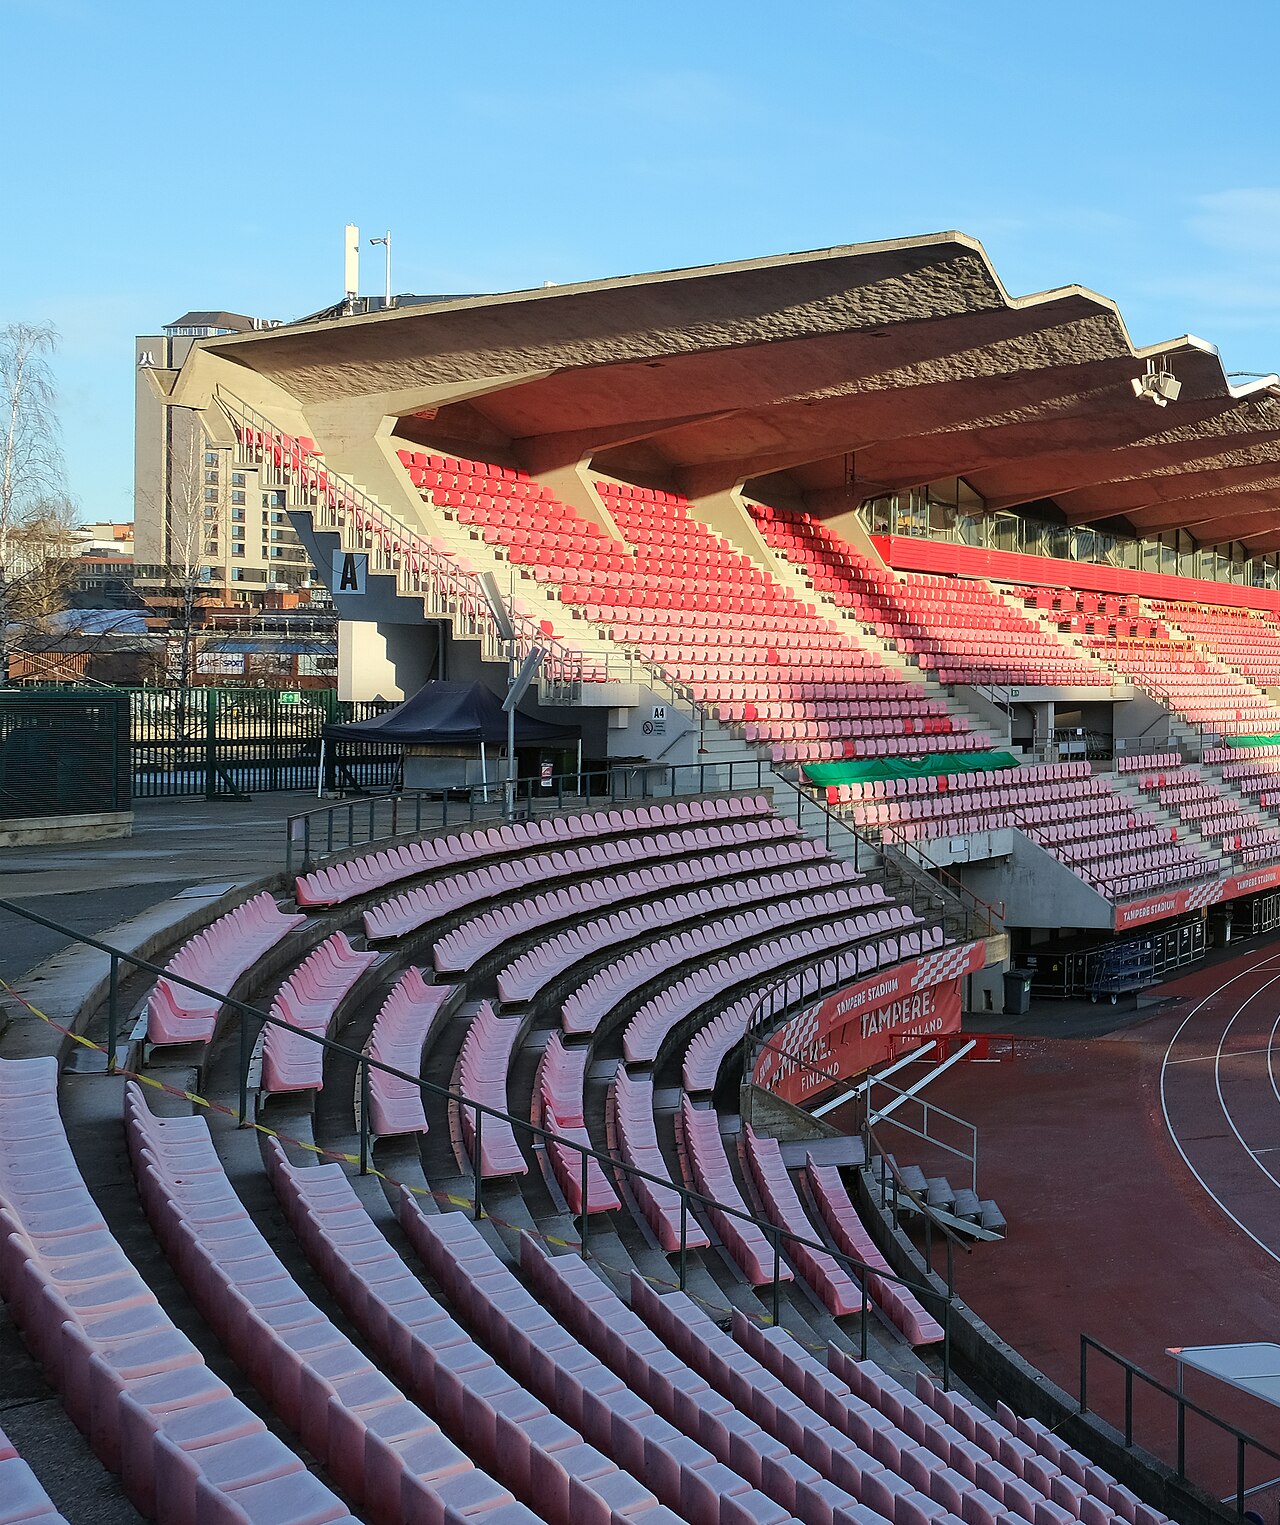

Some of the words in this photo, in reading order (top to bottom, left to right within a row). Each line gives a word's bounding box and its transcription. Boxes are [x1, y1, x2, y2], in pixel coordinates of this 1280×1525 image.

[340, 553, 358, 590] A
[654, 708, 664, 718] A4
[1237, 876, 1257, 890] TAMPERE
[1123, 907, 1149, 922] TAMPERE
[1150, 900, 1175, 915] STADIUM
[836, 994, 866, 1016] TAMPERE
[867, 978, 898, 1001] STADIUM
[902, 1017, 943, 1044] FINLAND
